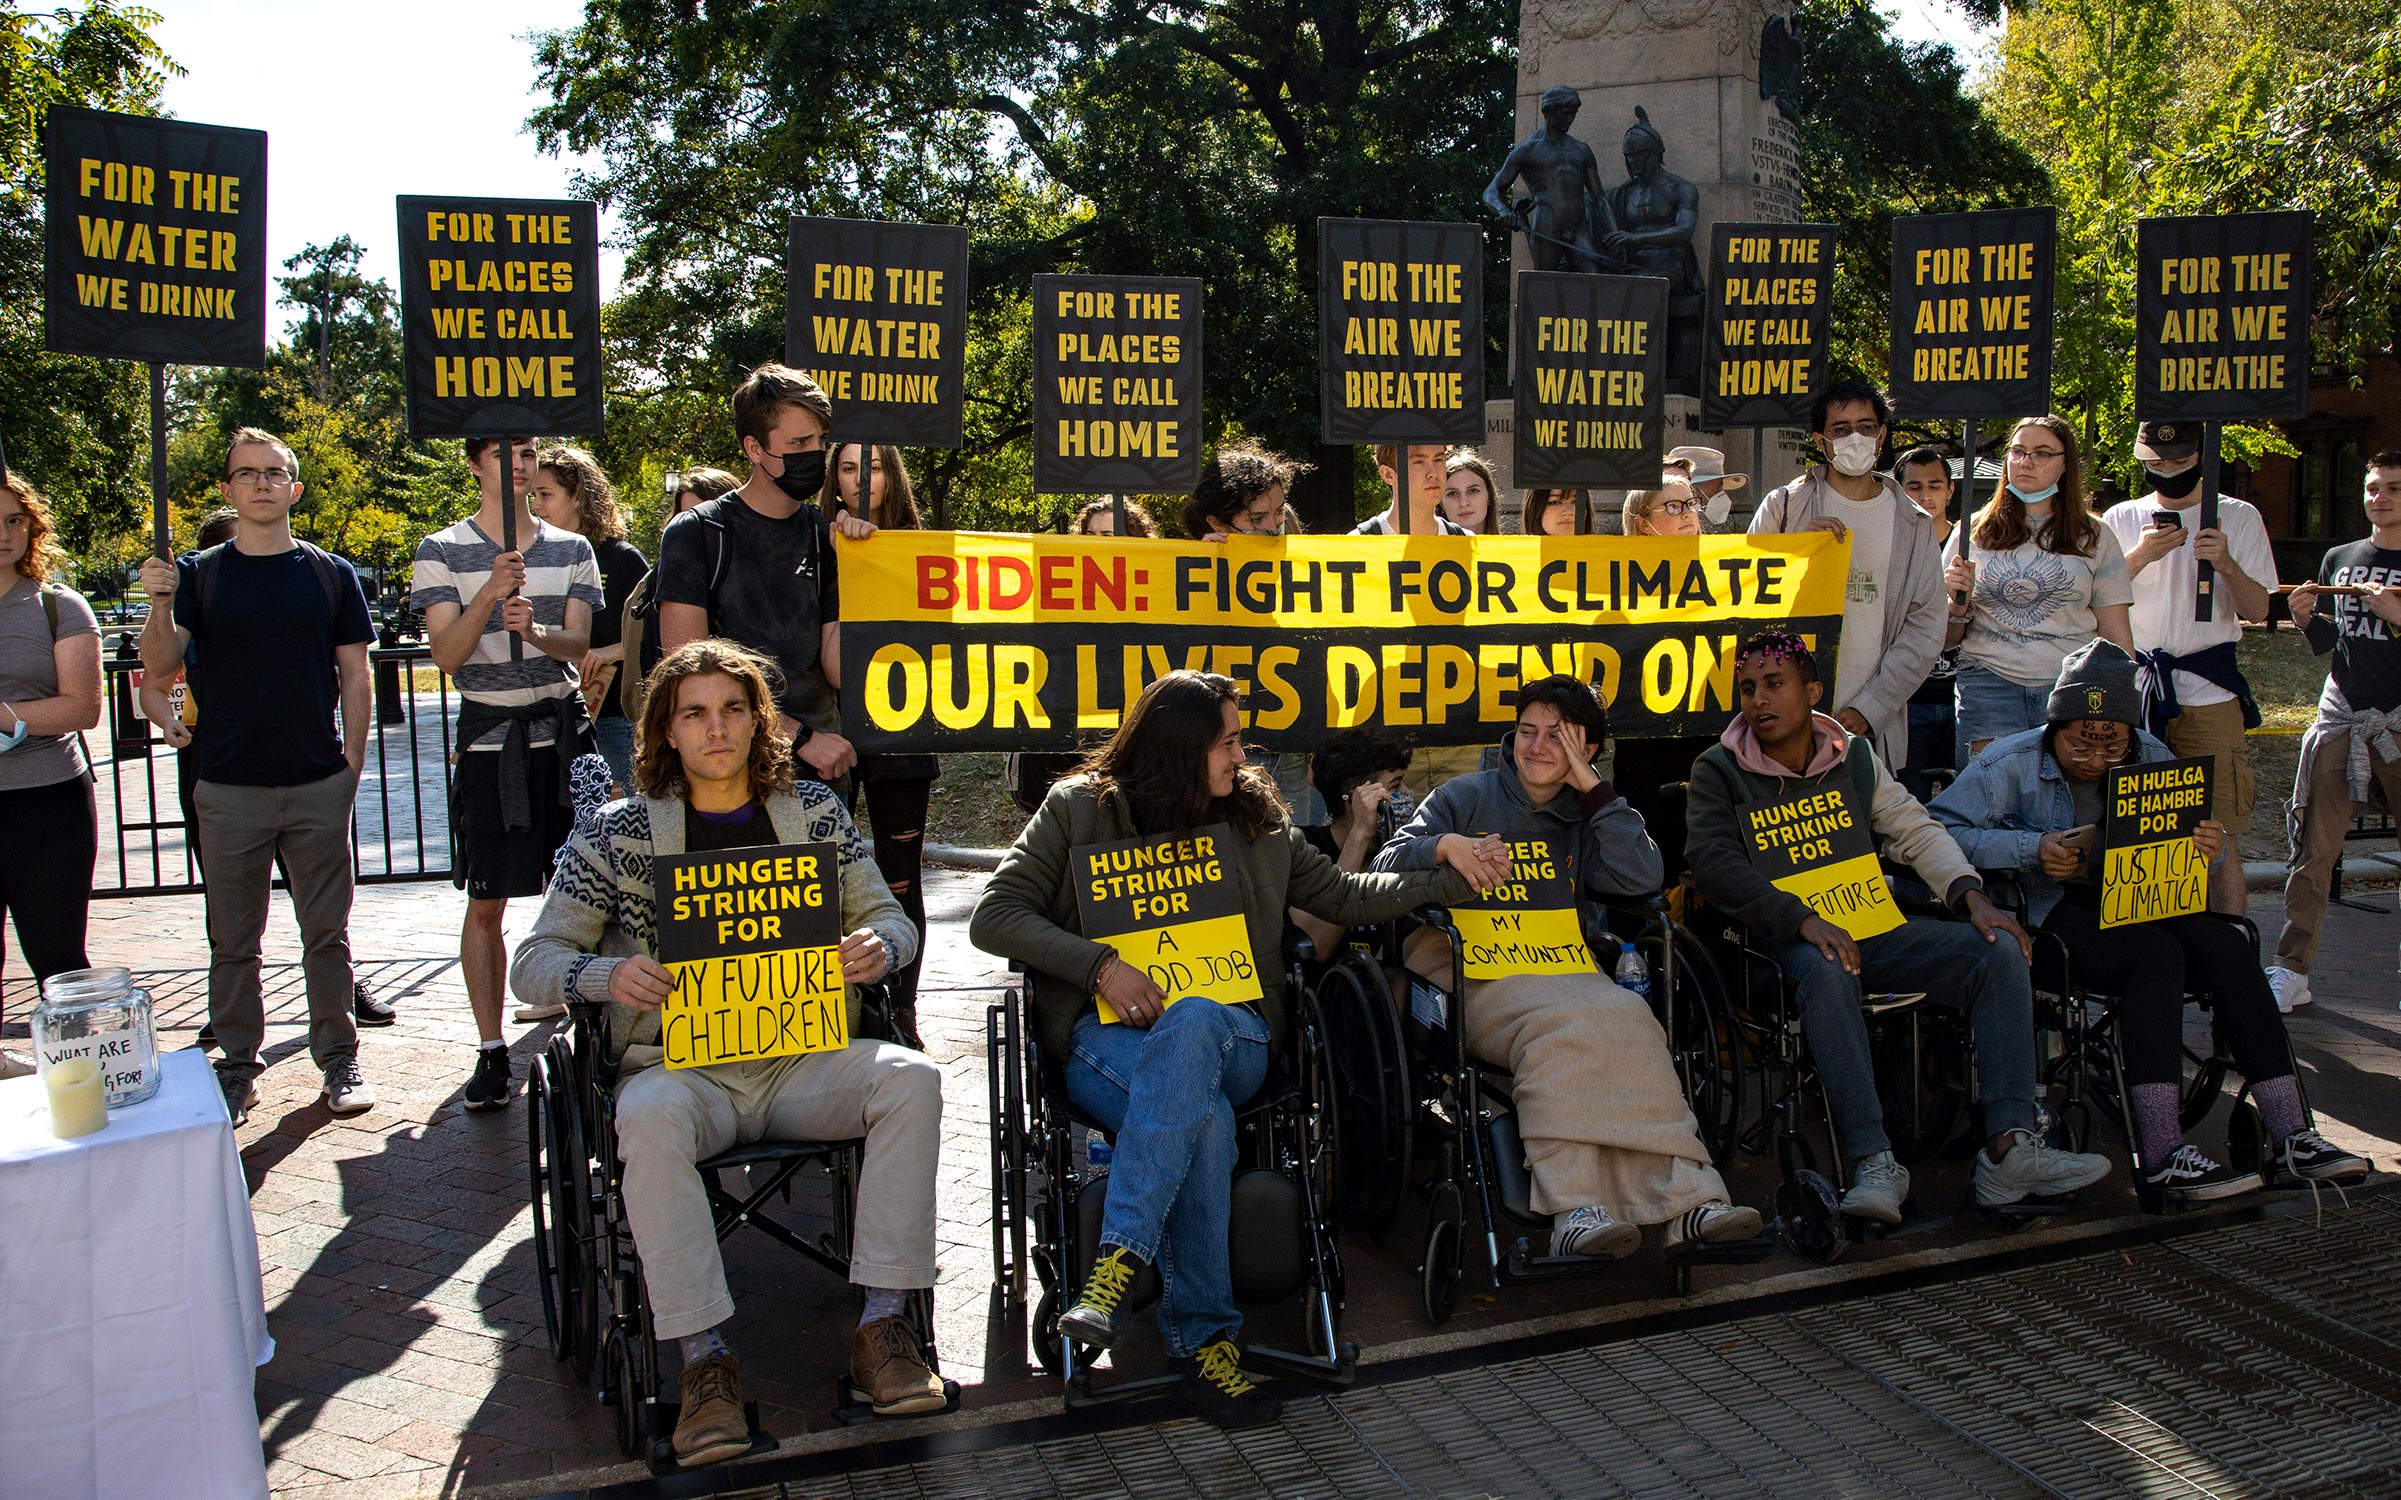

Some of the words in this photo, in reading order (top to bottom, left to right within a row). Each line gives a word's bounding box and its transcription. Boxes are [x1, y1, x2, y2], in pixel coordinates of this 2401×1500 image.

[81, 158, 154, 205] FOR
[169, 170, 238, 213] THE
[79, 215, 235, 271] WATER
[428, 212, 495, 242] FOR
[506, 214, 571, 244] THE
[1729, 238, 1771, 262] FOR
[1779, 239, 1819, 263] THE
[1916, 248, 1969, 285] FOR
[1980, 243, 2033, 281] THE
[430, 260, 572, 292] PLACES
[815, 264, 873, 301] FOR
[886, 268, 943, 305] THE
[1343, 261, 1398, 301] FOR
[1407, 263, 1461, 303] THE
[1725, 279, 1816, 305] PLACES
[2162, 257, 2220, 294] FOR
[2232, 254, 2289, 291] THE
[77, 274, 127, 310] WE
[140, 282, 235, 319] DRINK
[1059, 291, 1115, 318] FOR
[1125, 293, 1180, 319] THE
[1914, 299, 1968, 334] AIR
[1980, 296, 2030, 331] WE
[432, 308, 485, 338] WE
[497, 309, 573, 339] CALL
[813, 316, 940, 359] WATER
[1344, 317, 1398, 355] AIR
[1410, 319, 1461, 356] WE
[1538, 317, 1587, 352] FOR
[1598, 320, 1647, 354] THE
[1724, 320, 1755, 345] WE
[1762, 319, 1811, 345] CALL
[2161, 309, 2218, 343] AIR
[2232, 306, 2286, 340] WE
[1059, 333, 1180, 363] PLACES
[1914, 345, 2028, 381] BREATHE
[435, 356, 575, 397] HOME
[811, 370, 851, 399] WE
[861, 372, 938, 403] DRINK
[1058, 377, 1102, 404] WE
[1114, 378, 1178, 405] CALL
[1346, 371, 1462, 408] BREATHE
[1537, 368, 1643, 406] WATER
[1720, 360, 1810, 396] HOME
[2161, 356, 2284, 391] BREATHE
[1059, 420, 1178, 457] HOME
[1487, 419, 1514, 433] MIL
[1535, 420, 1568, 447] WE
[1576, 421, 1642, 448] DRINK
[916, 555, 1149, 612] BIDEN:
[1175, 556, 1366, 613] FIGHT
[1388, 559, 1518, 614] FOR
[1537, 557, 1787, 613] CLIMATE
[864, 642, 1052, 732] OUR
[1326, 641, 1621, 729] DEPEND
[1641, 634, 1738, 714] ON
[2083, 720, 2096, 731] US
[2102, 721, 2116, 731] OR
[2118, 775, 2139, 794] EN
[2143, 766, 2204, 791] HUELGA
[1750, 790, 1844, 829] HUNGER
[2117, 798, 2136, 817] DE
[2142, 788, 2204, 813] HAMBRE
[1755, 810, 1853, 851] STRIKING
[2140, 813, 2177, 834] POR
[1089, 836, 1216, 876] HUNGER
[1788, 839, 1833, 864] FOR
[674, 855, 818, 892] HUNGER
[1090, 860, 1222, 902] STRIKING
[673, 883, 822, 921] STRIKING
[1133, 892, 1189, 920] FOR
[1806, 876, 1886, 916] FUTURE
[2101, 875, 2202, 925] CLIMATICA
[718, 916, 781, 944] FOR
[1491, 913, 1521, 931] MY
[1157, 930, 1179, 955] A
[1462, 940, 1586, 965] COMMUNITY
[664, 960, 709, 1011] MY
[722, 948, 842, 1003] FUTURE
[1147, 961, 1194, 993] OD
[1196, 950, 1253, 986] JOB
[98, 1039, 132, 1059] ARE
[665, 998, 842, 1064] CHILDREN
